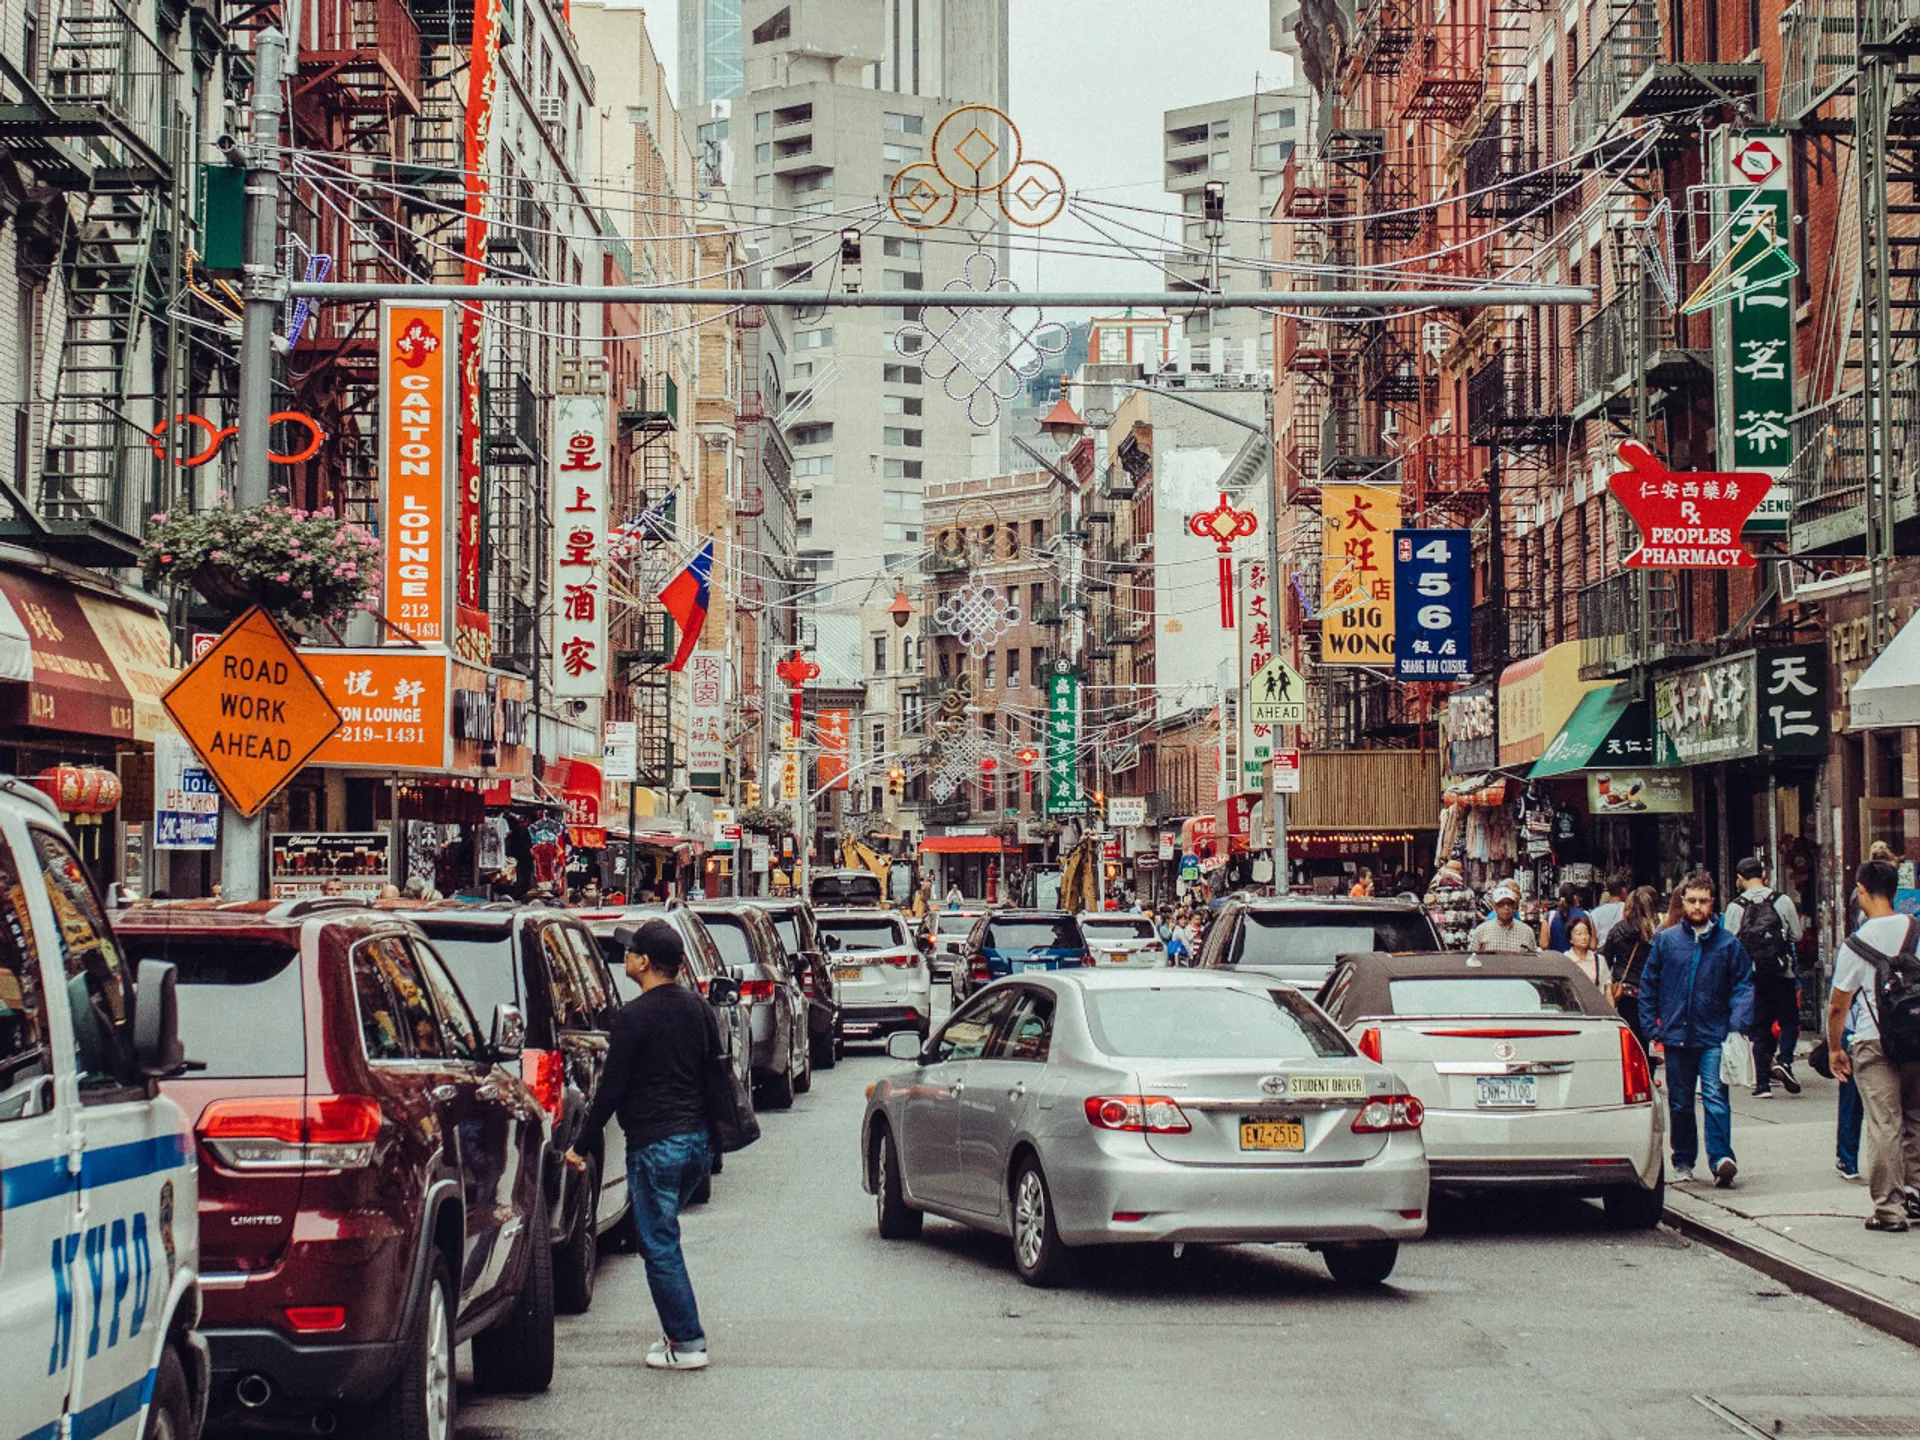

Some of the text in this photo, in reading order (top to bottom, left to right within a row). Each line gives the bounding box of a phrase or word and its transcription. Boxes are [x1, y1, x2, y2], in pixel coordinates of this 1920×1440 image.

[1732, 203, 1791, 454] 天仁茗茶
[400, 375, 431, 475] CANTON
[1639, 480, 1741, 500] 仁安西藥房
[1755, 499, 1792, 512] SENG
[1344, 494, 1378, 572] 大旺
[1651, 528, 1731, 545] PEOPLES
[399, 495, 430, 597] LOUNGE
[559, 430, 602, 677] 皇上皇酒家
[1641, 548, 1741, 566] PHARMACY
[1416, 540, 1451, 630] 456
[401, 603, 429, 619] 212
[1342, 607, 1382, 629] BIG
[1329, 633, 1396, 655] WONG
[224, 655, 288, 685] ROAD
[313, 669, 425, 706] 悅軒
[1767, 656, 1820, 739] 天仁
[221, 693, 286, 723] WORK
[366, 707, 421, 723] LOUNGE
[1256, 709, 1299, 719] AHEAD
[334, 727, 425, 743] -219-1431
[210, 731, 292, 762] AHEAD
[1254, 746, 1270, 758] NEW
[1292, 1078, 1329, 1092] STUDENT
[1332, 1078, 1361, 1092] DRIVER
[231, 1215, 282, 1225] LIMITED
[48, 1212, 151, 1377] NYPD
